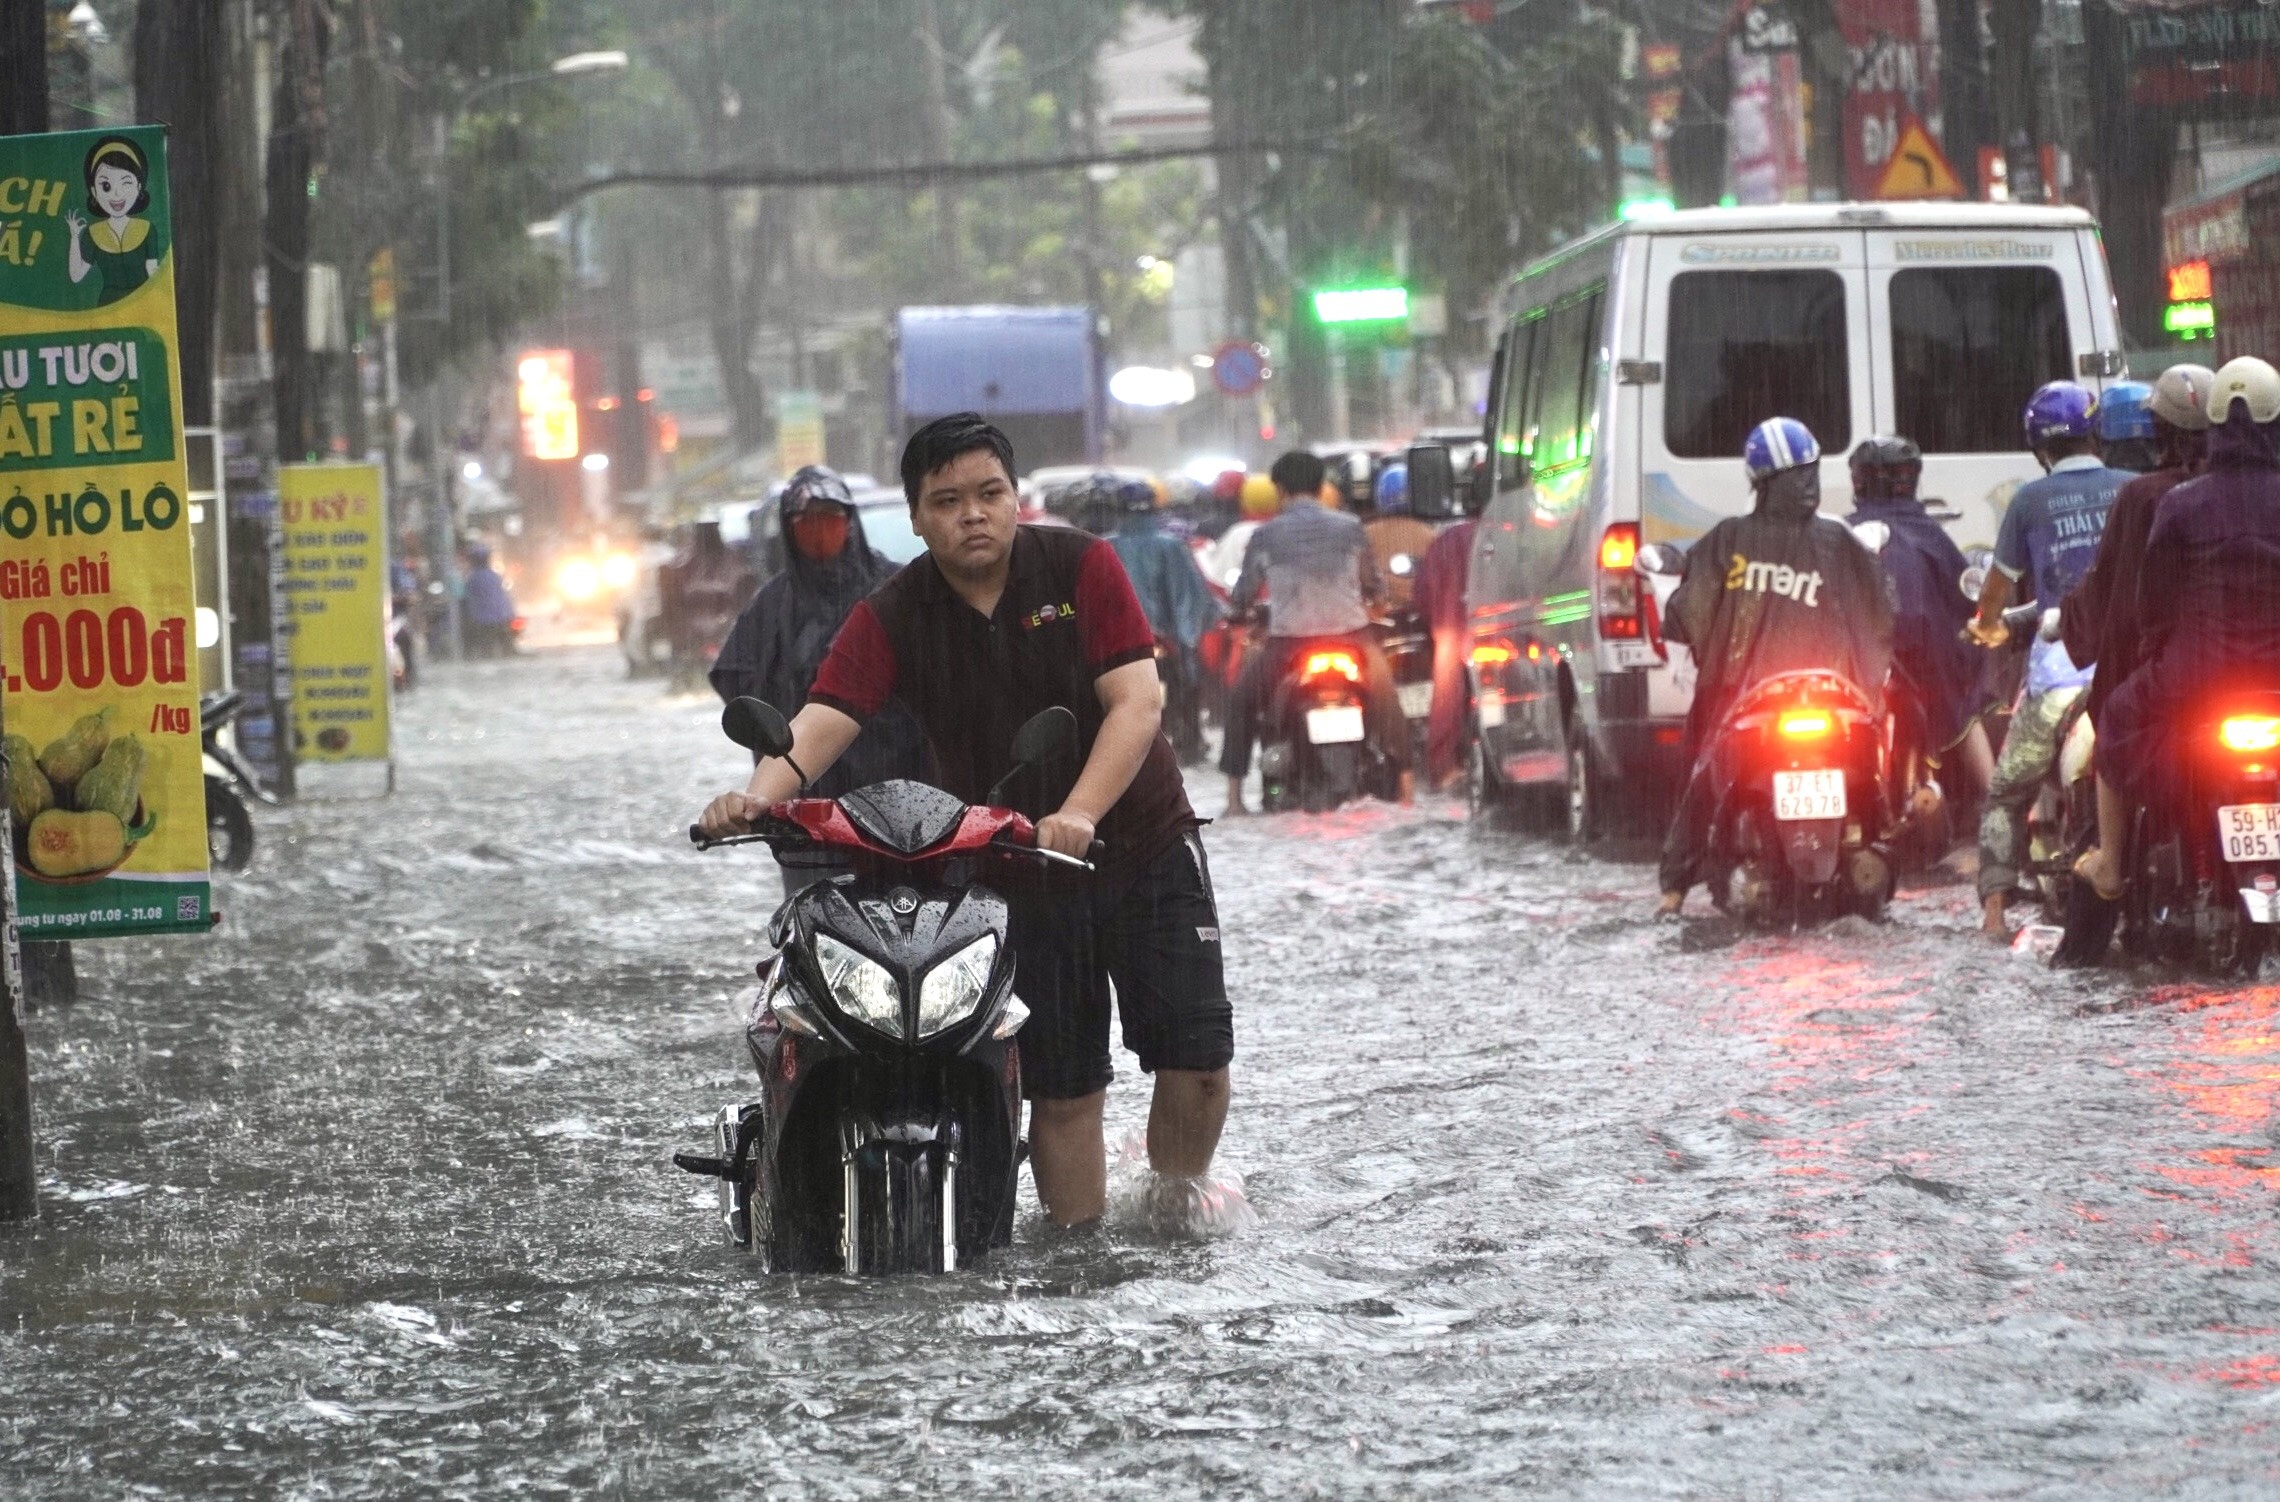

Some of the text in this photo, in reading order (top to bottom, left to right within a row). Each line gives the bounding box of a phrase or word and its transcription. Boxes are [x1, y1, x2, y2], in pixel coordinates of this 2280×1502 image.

[0, 341, 139, 389] U TƯƠI
[72, 384, 144, 454] RẺ
[0, 481, 180, 539] Ỏ HỒ LÔ
[2055, 511, 2092, 537] THÁI
[0, 551, 111, 600] Giá chỉ
[0, 607, 187, 692] .000đ
[150, 703, 191, 735] /kg
[2232, 807, 2280, 832] 59-H
[89, 908, 122, 922] 01.08
[132, 908, 162, 921] 31.08
